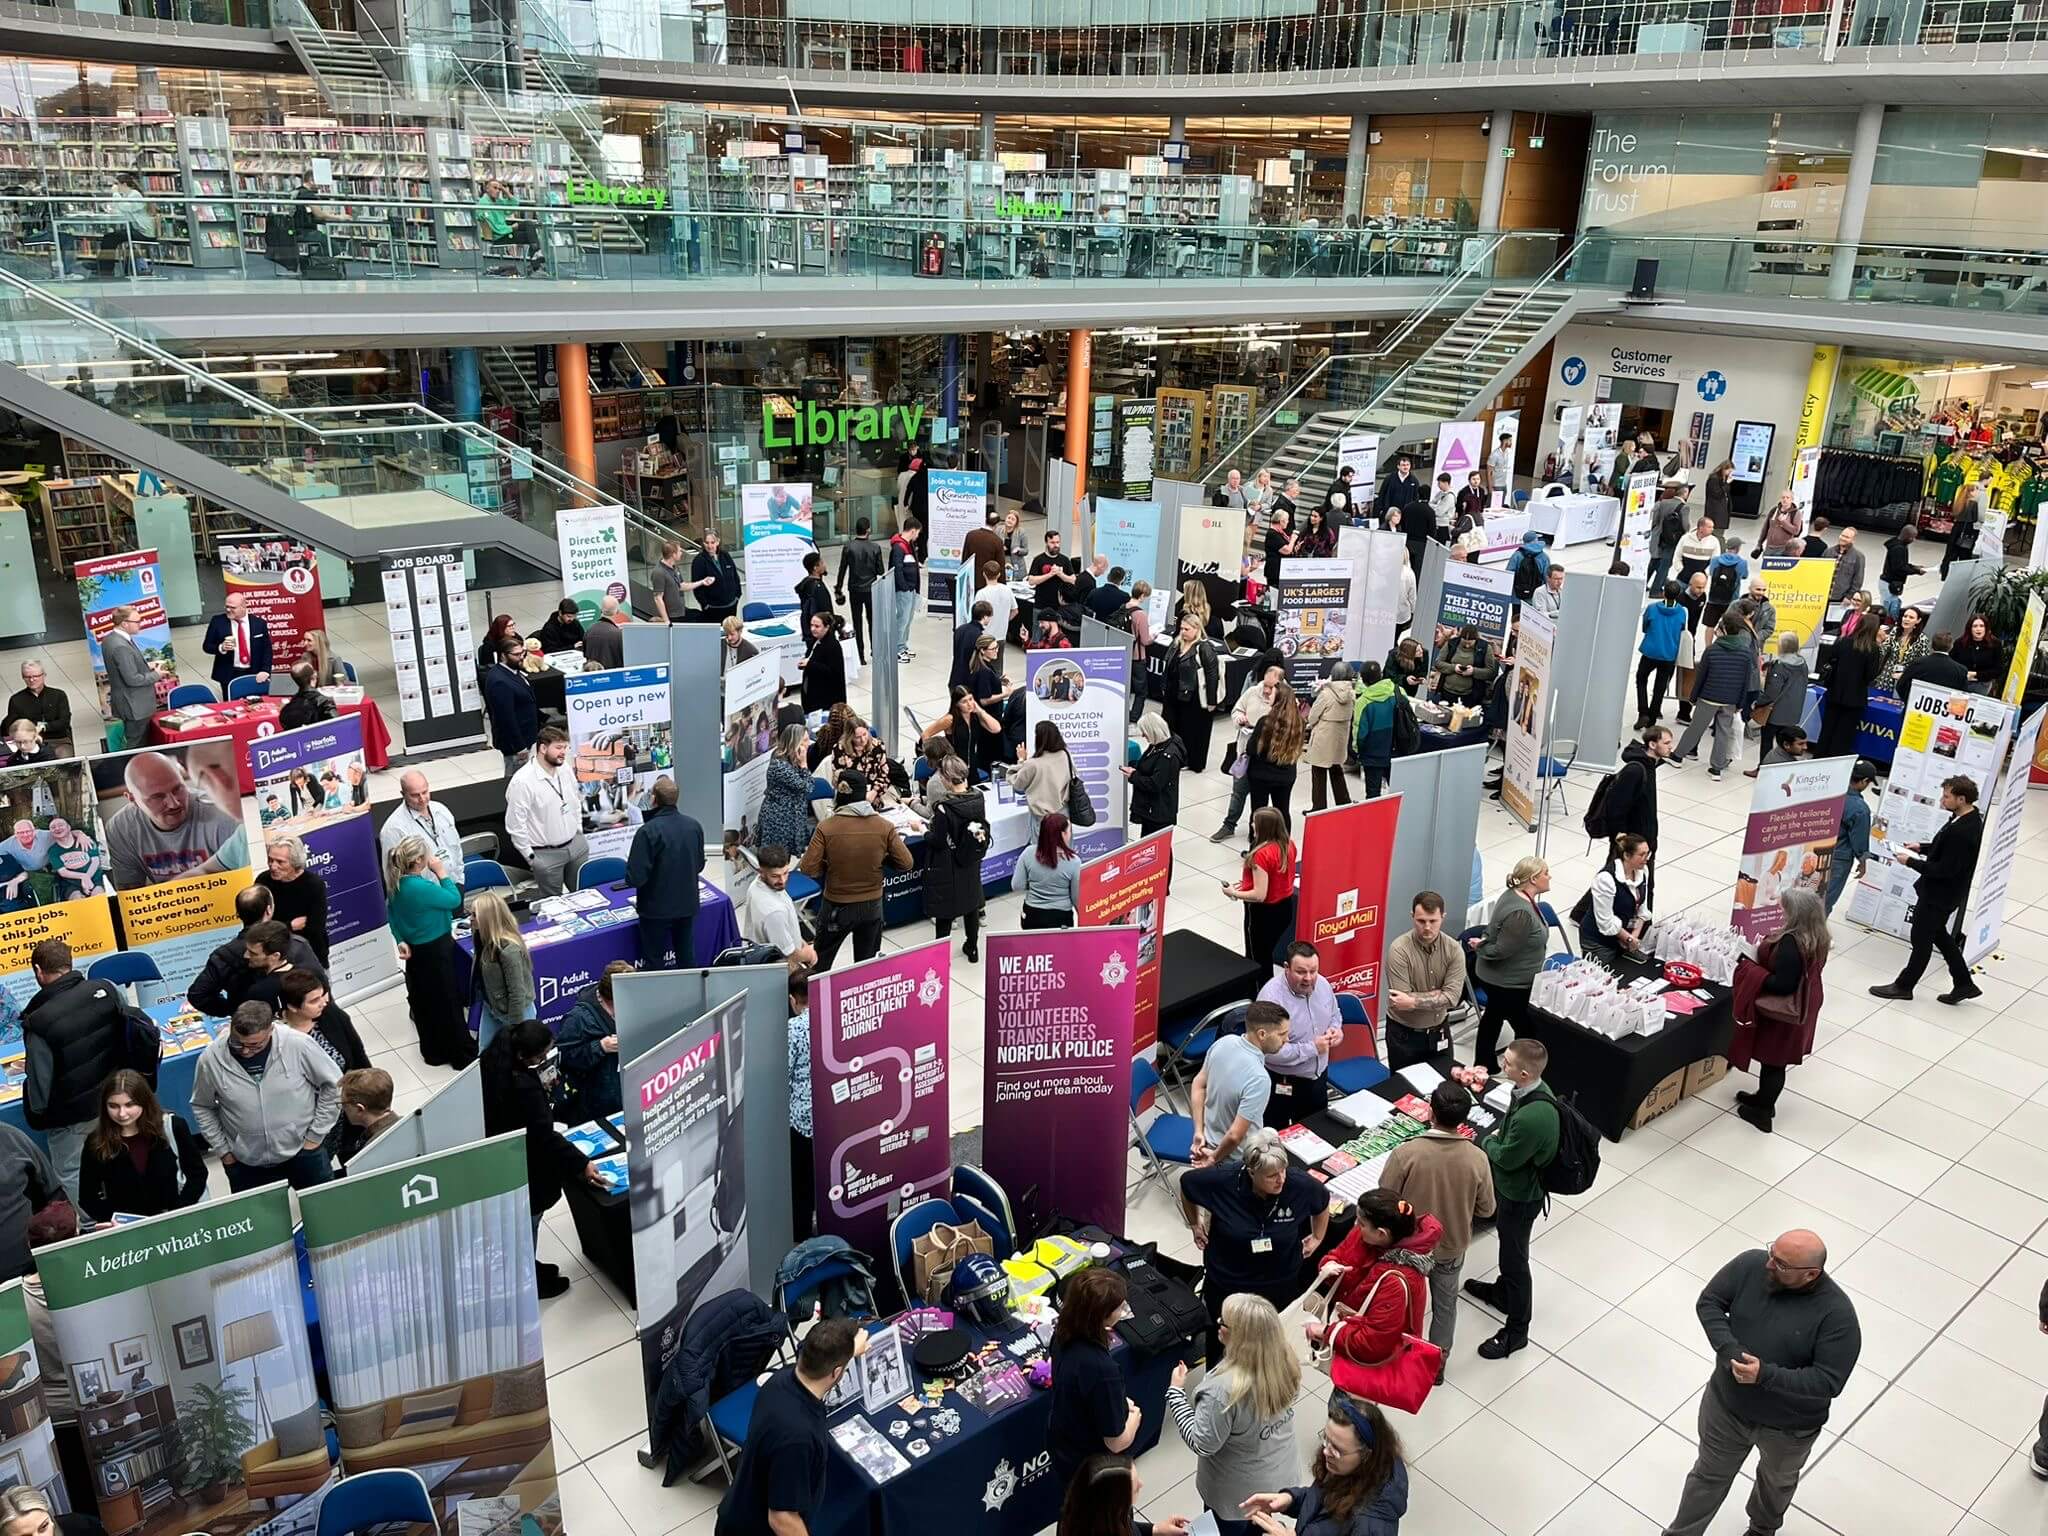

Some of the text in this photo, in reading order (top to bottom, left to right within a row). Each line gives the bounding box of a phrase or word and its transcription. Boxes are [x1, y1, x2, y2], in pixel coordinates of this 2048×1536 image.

[1595, 129, 1637, 153] The
[1590, 159, 1668, 184] Forum
[567, 177, 666, 209] Library
[1586, 188, 1639, 213] Trust
[995, 192, 1062, 220] Library
[1611, 347, 1672, 364] Customer
[1612, 361, 1666, 377] Services
[763, 400, 924, 449] Library
[1796, 393, 1819, 446] Stall City
[931, 477, 946, 486] Join
[947, 478, 961, 486] Our
[569, 535, 600, 546] Direct
[391, 553, 455, 569] JOB BOARD
[570, 545, 617, 559] Payment
[571, 557, 614, 571] Support
[572, 569, 616, 582] Services
[260, 597, 297, 605] PORTRAITS
[1282, 596, 1345, 605] FOOD BUSINESSES
[1305, 587, 1346, 597] LARGEST
[1767, 589, 1824, 604] brighter
[1443, 603, 1502, 623] INDUSTRY FROM
[1445, 594, 1504, 614] THE FOOD
[91, 616, 99, 626] A
[267, 613, 295, 621] CANADA
[1466, 616, 1478, 626] TO
[271, 628, 299, 637] CRUISES
[572, 691, 666, 713] Open up new
[599, 708, 644, 727] doors!
[1048, 711, 1104, 721] EDUCATION
[1856, 720, 1896, 741] VIVA
[311, 735, 337, 747] Norfolk
[271, 746, 288, 757] Adult
[271, 751, 298, 764] Learning
[1795, 772, 1831, 787] Kingsley
[1769, 807, 1831, 823] Flexible tailored
[1761, 818, 1835, 833] care in the comfort
[1761, 828, 1830, 844] of your own home
[154, 886, 174, 900] the
[176, 880, 207, 894] most
[207, 877, 228, 893] job
[128, 894, 200, 916] satisfaction
[1085, 897, 1110, 913] Looking
[1109, 892, 1119, 901] for
[14, 916, 36, 926] are
[37, 909, 69, 924] jobs,
[155, 913, 183, 925] ever
[1318, 910, 1374, 936] Royal Mail
[2, 925, 49, 942] this job
[134, 919, 213, 944] Tony, Support
[73, 941, 104, 954] orker
[999, 954, 1054, 974] WE ARE
[561, 970, 590, 986] Adult
[999, 971, 1066, 993] OFFICERS
[840, 978, 915, 1014] POLICE OFFICER
[998, 991, 1042, 1011] STAFF
[841, 994, 908, 1028] RECRUITMENT
[998, 1006, 1089, 1029] VOLUNTEERS
[841, 1014, 884, 1042] JOURNEY
[998, 1023, 1097, 1046] TRANSFEREES
[997, 1039, 1114, 1064] NORFOLK POLICE
[642, 1039, 715, 1102] TODAY, I
[995, 1083, 1114, 1103] joining our team today
[996, 1075, 1104, 1092] Find out more about
[642, 1072, 706, 1121] helped officers
[643, 1093, 692, 1134] make it to a
[644, 1092, 711, 1146] domestic abuse
[645, 1094, 728, 1158] incident just in time.
[84, 1216, 254, 1279] A better what’s next
